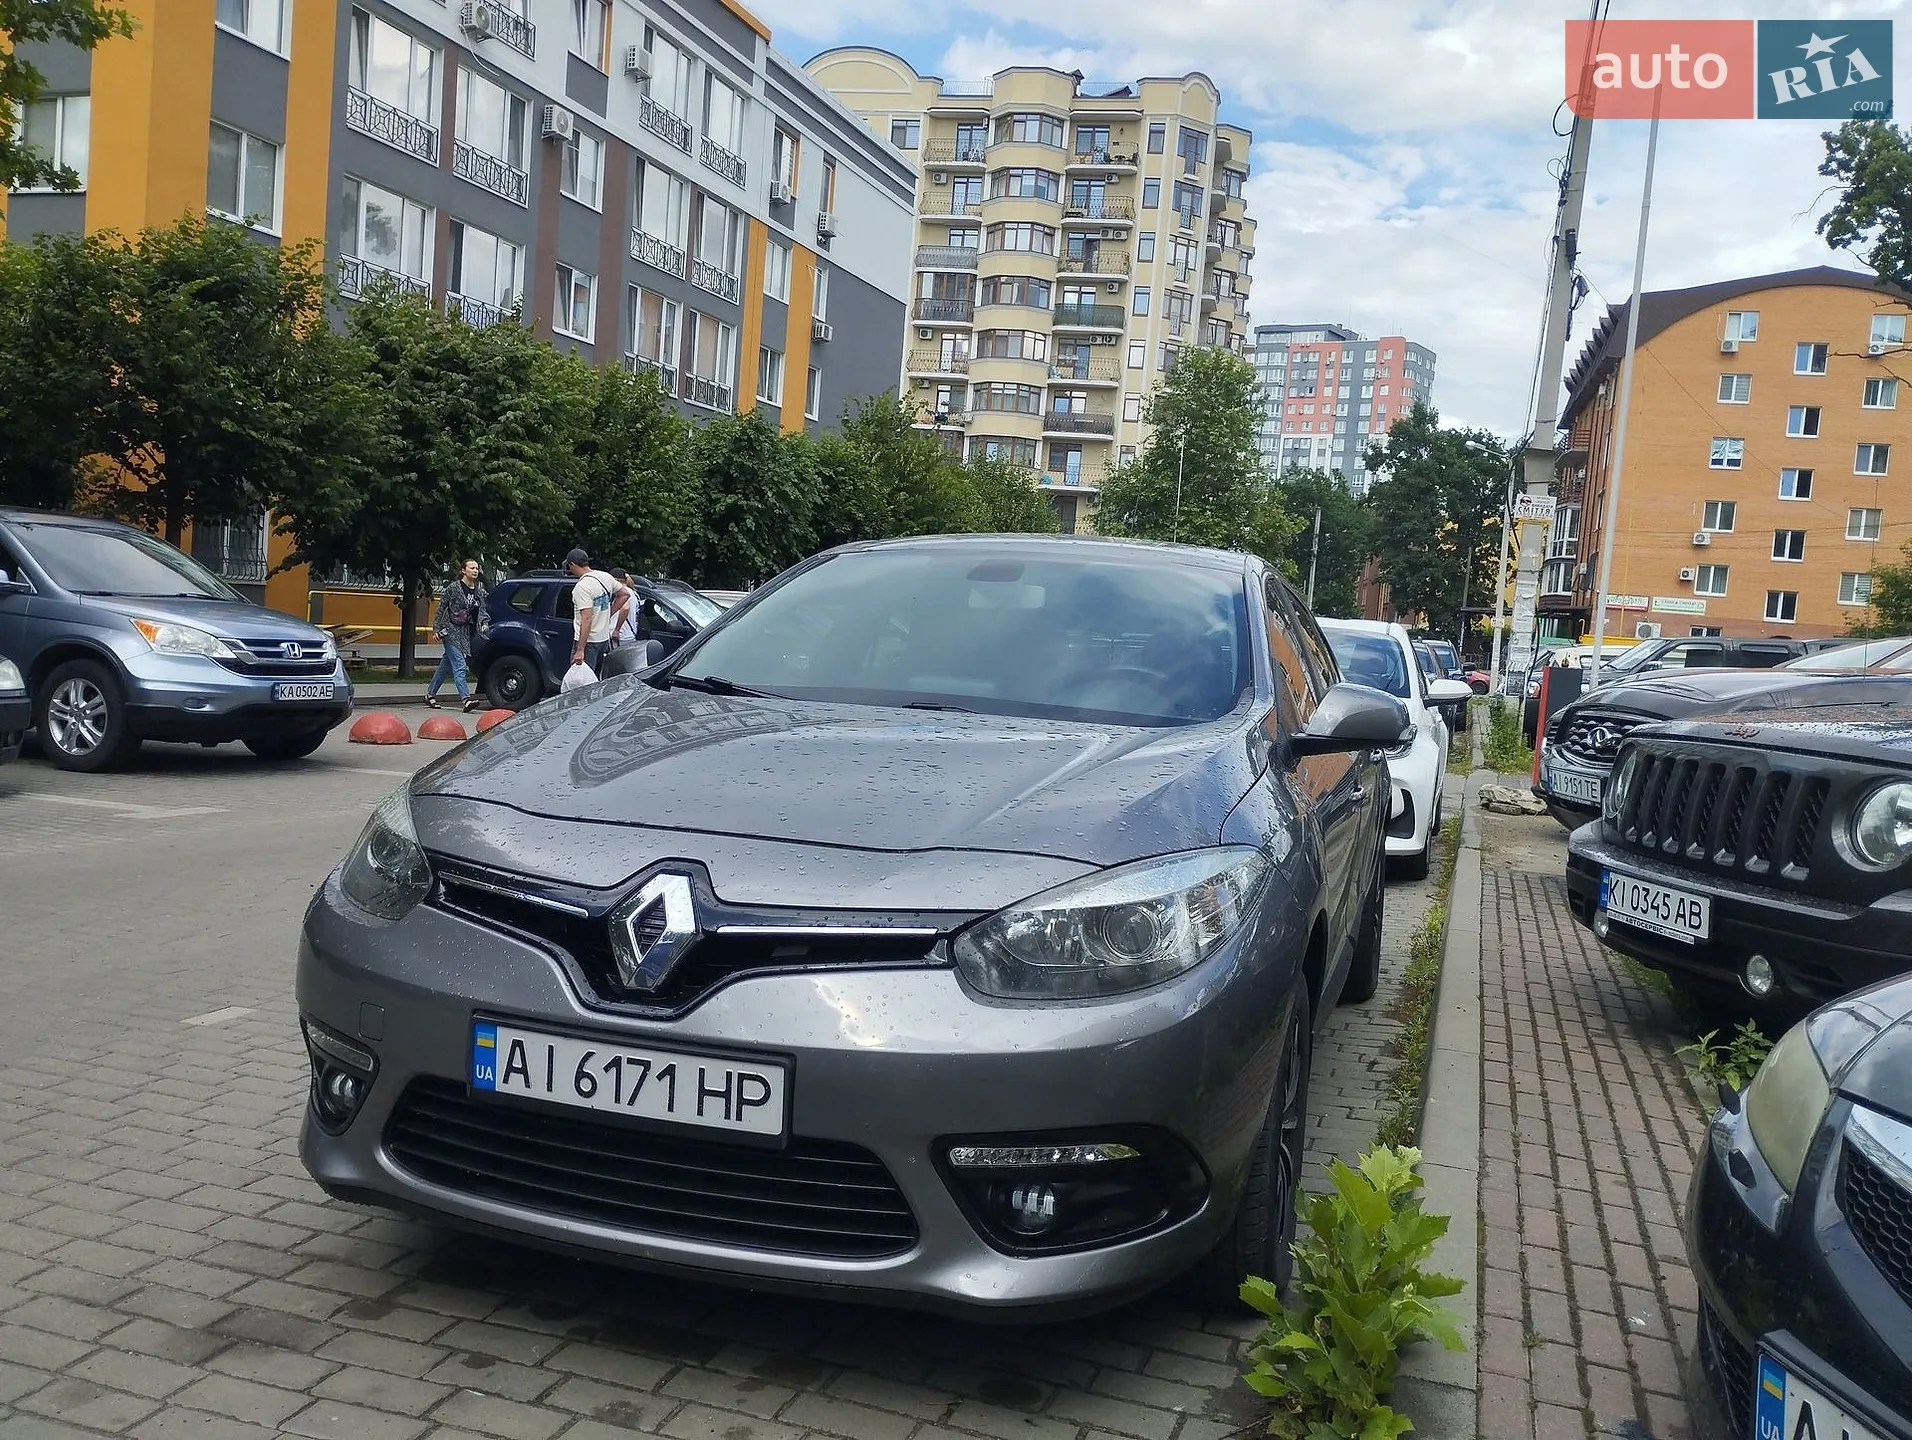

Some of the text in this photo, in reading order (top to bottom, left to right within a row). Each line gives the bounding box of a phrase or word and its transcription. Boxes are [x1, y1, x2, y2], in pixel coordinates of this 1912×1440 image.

[280, 686, 332, 698] KA 0502 AE
[1563, 776, 1583, 796] 9151
[1584, 780, 1598, 799] TE
[1608, 877, 1626, 908] KI
[1631, 884, 1671, 921] 0345
[1674, 897, 1703, 930] AB
[476, 1064, 494, 1081] UA
[502, 1037, 772, 1122] AI 6171 HP
